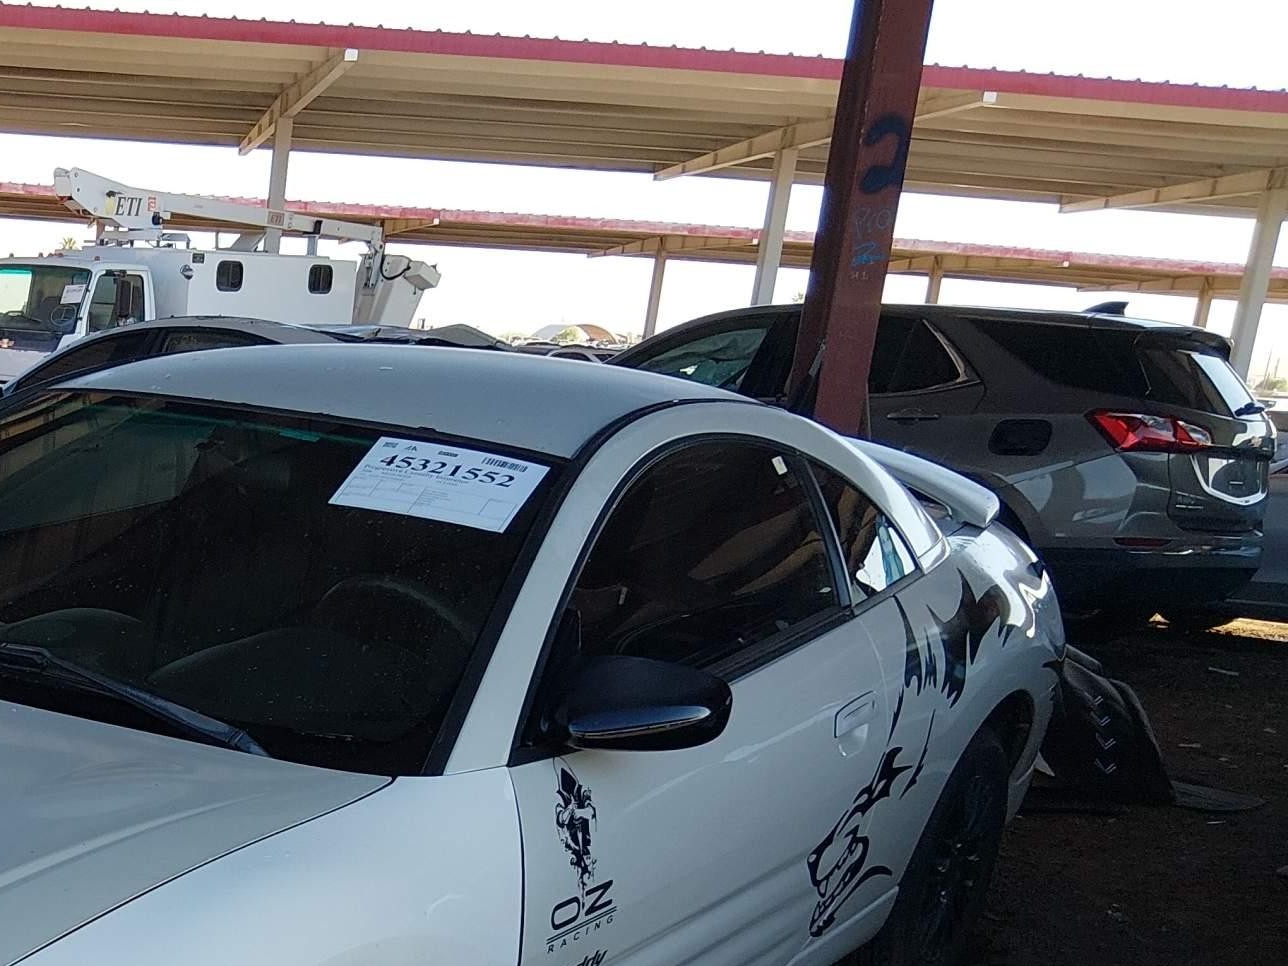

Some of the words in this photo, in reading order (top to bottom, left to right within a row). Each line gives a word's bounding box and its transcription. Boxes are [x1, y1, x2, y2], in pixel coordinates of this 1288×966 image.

[115, 196, 143, 216] ETI
[379, 453, 515, 488] 45321552
[550, 879, 614, 931] OZ
[546, 916, 614, 954] RACING
